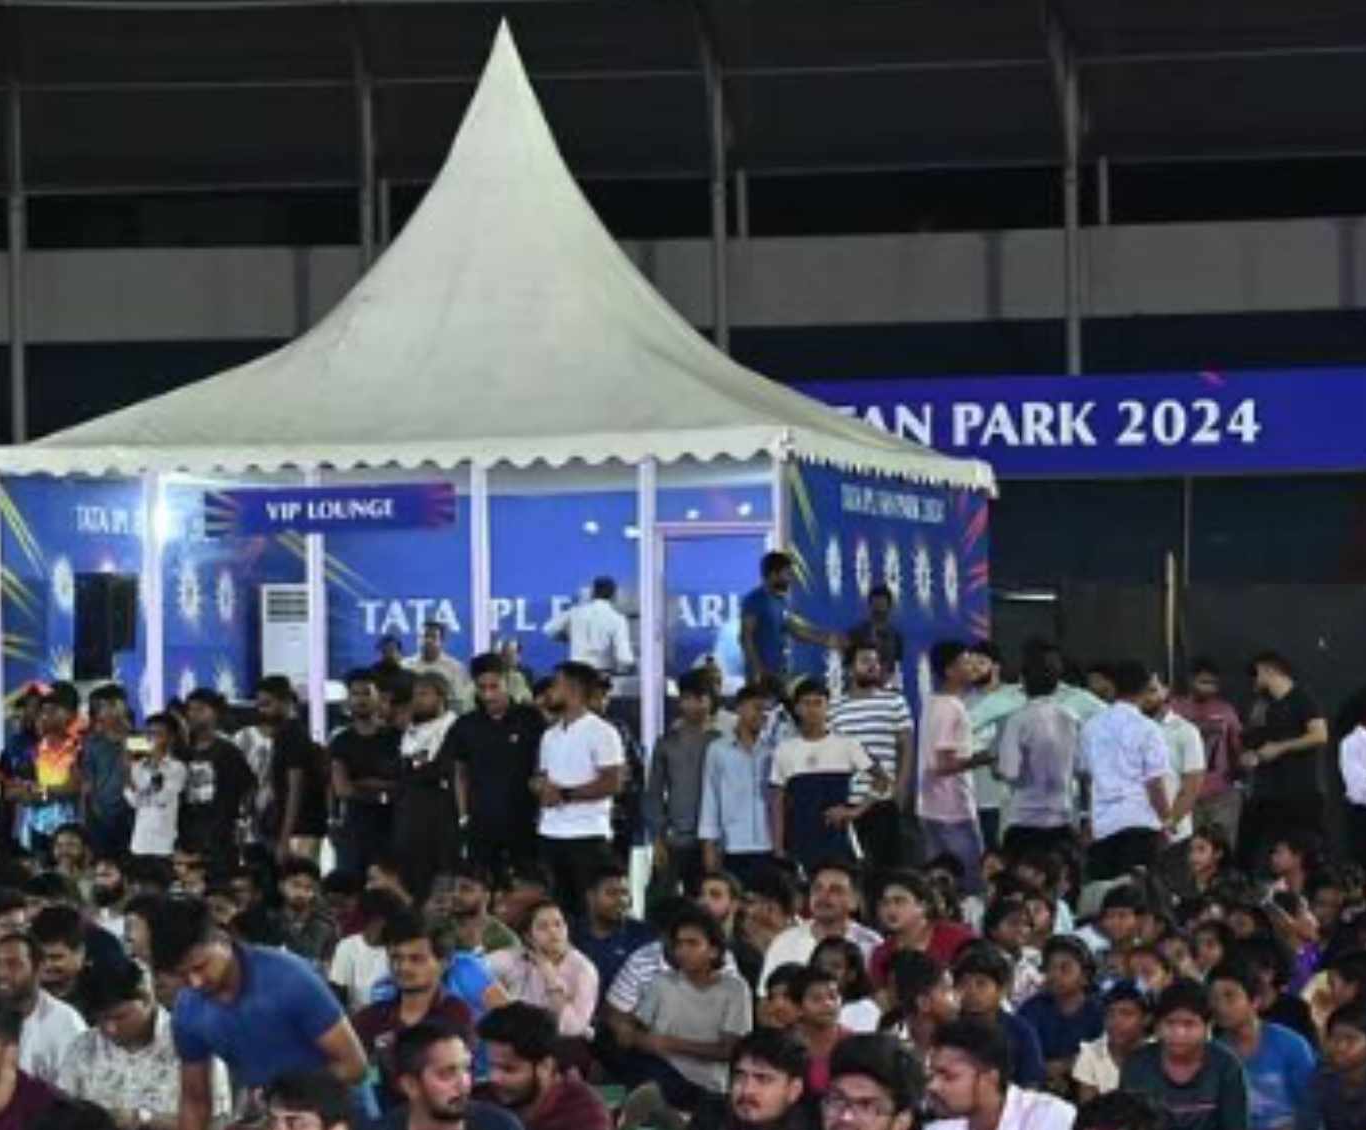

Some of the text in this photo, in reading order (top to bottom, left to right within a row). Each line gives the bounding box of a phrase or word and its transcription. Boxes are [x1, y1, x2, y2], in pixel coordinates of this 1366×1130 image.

[952, 401, 1097, 446] PARK
[1116, 399, 1261, 445] 2024
[265, 498, 396, 522] VIP LOUNGE
[358, 598, 462, 634] TATA
